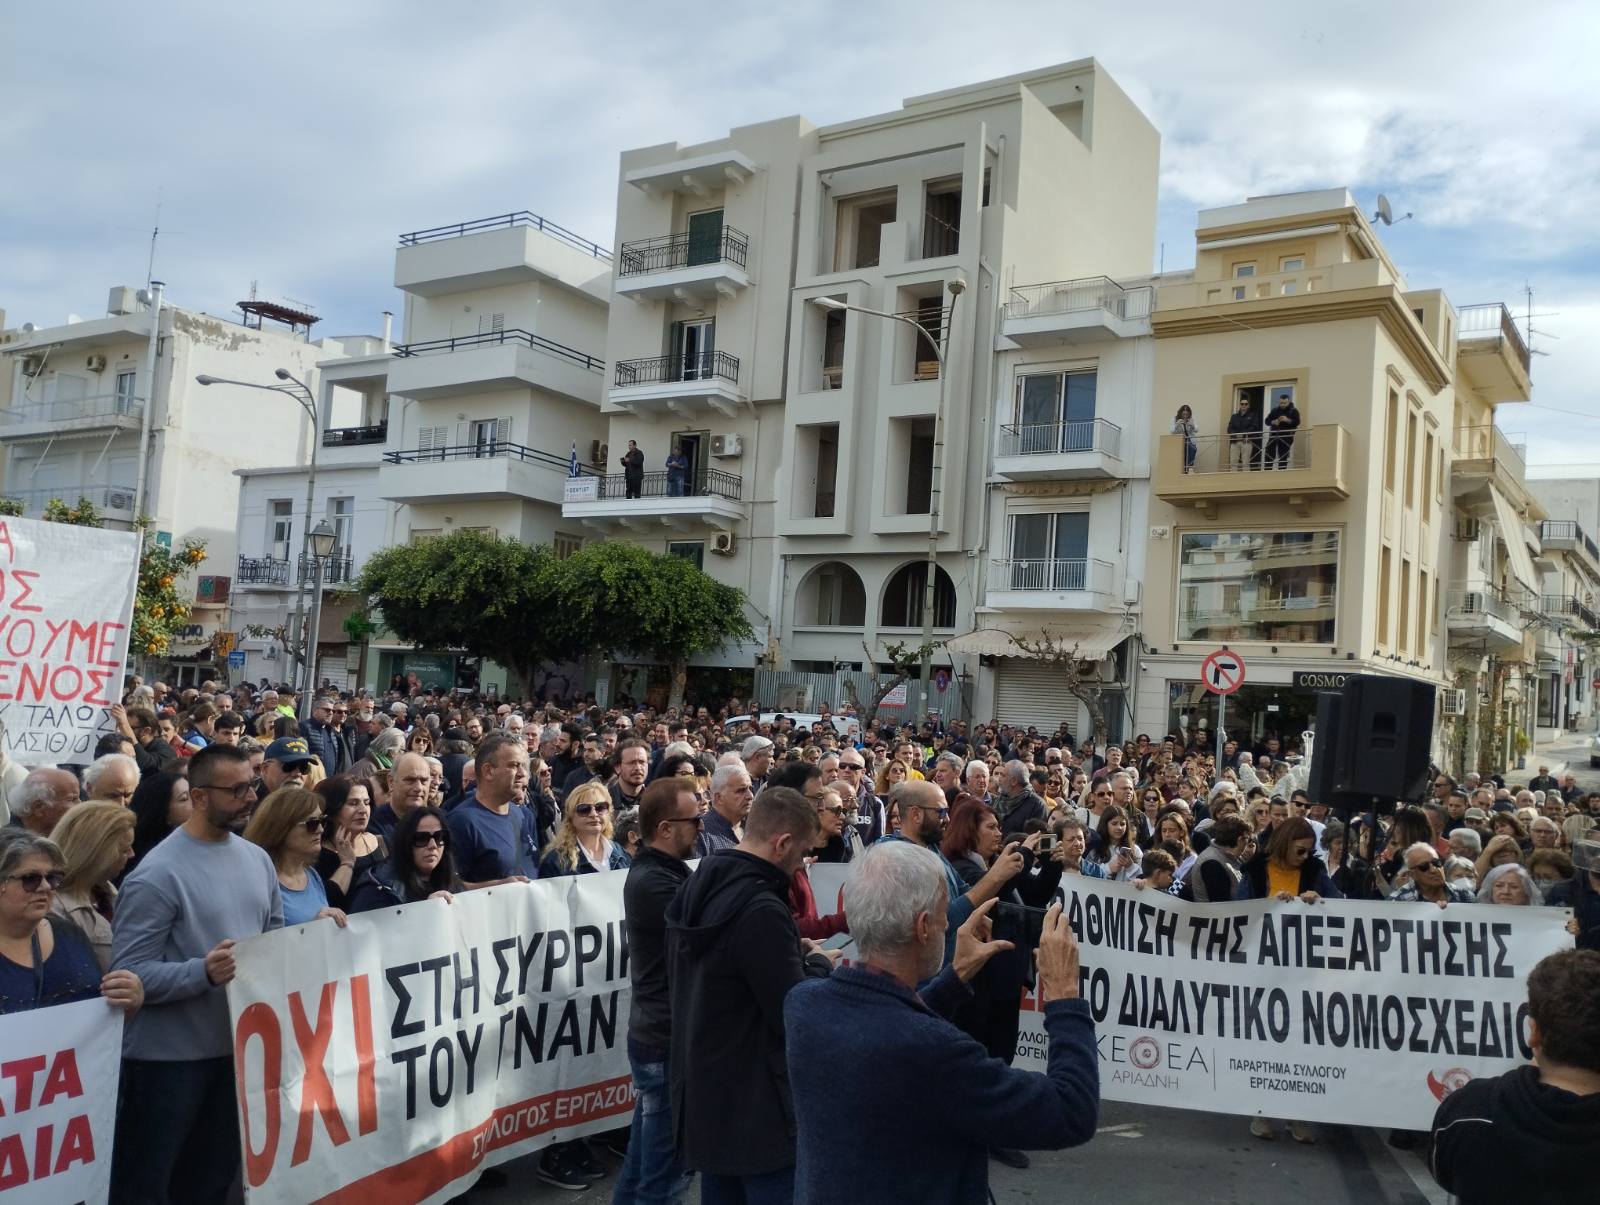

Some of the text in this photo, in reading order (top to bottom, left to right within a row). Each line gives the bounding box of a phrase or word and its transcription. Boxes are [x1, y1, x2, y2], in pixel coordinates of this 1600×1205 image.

[1300, 674, 1351, 687] COSMO
[1189, 915, 1248, 964] ΤΗΣ
[1257, 913, 1515, 978] ΑΠΕΞΑΡΤΗΣΗΣ
[385, 947, 480, 1039] ΣΤΗ
[1118, 973, 1290, 1043] ΔΙΑΛΥΤΙΚΟ
[1302, 990, 1534, 1061] ΝΟΜΟΣΧΕΔΙΟ
[0, 1047, 84, 1117] ΤΑ
[236, 973, 378, 1188] ΟΧΙ
[392, 1023, 484, 1120] ΤΟΥ
[1015, 1046, 1048, 1061] ΟΓΕΝ
[1112, 1069, 1179, 1089] ΑΡΙΑΔΝΗ
[1229, 1058, 1347, 1079] ΠΑΡΑΡΤΗΜΑ ΣΥΛΛΟΓΟΥ
[1250, 1076, 1326, 1094] ΕΡΓΑΖΟΜΕΝΩΝ
